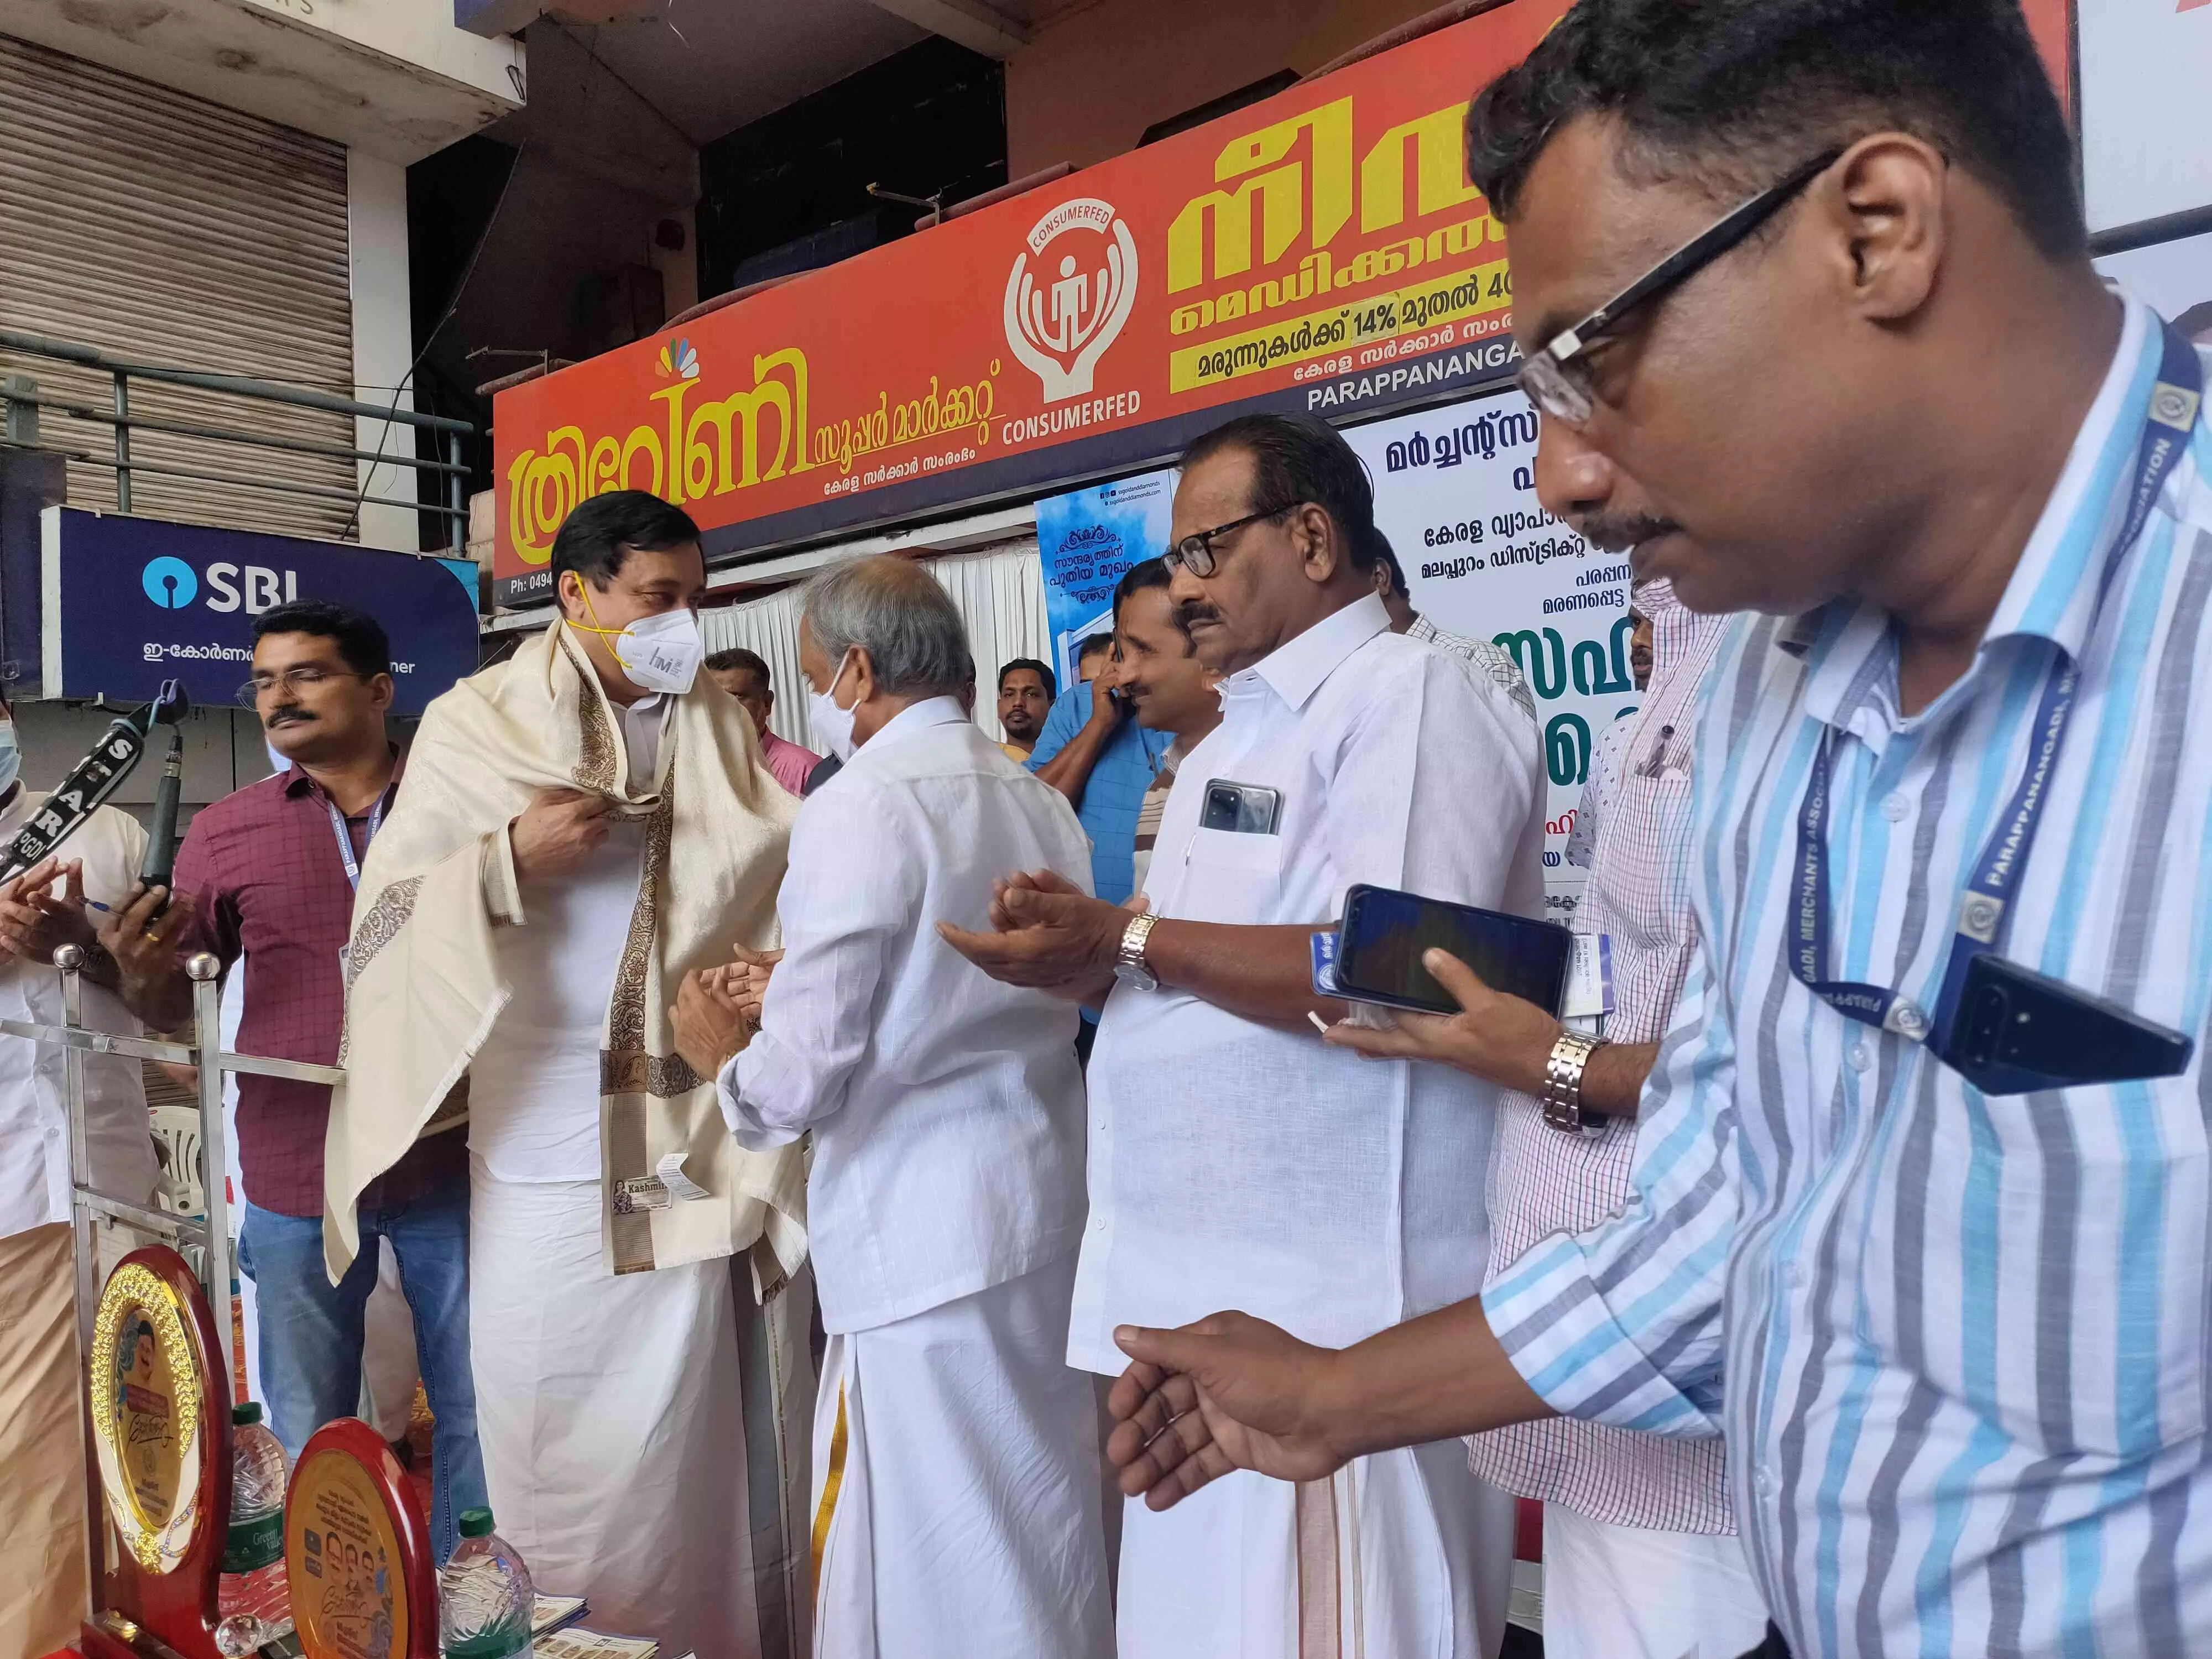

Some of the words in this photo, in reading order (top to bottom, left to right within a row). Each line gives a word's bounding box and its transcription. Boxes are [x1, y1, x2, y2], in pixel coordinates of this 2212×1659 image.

[1032, 205, 1110, 248] CONSUMERFED
[1198, 309, 1350, 377] മരുന്നുകൾക്ക്
[1354, 302, 1397, 336] 14%
[1402, 274, 1479, 327] മുതൽ
[1293, 355, 1353, 380] കേരള
[1360, 325, 1455, 365] സർക്കാർ
[815, 391, 888, 474] സൂപ്പർ
[893, 358, 1000, 446] മാർക്കറ്റ്
[1002, 390, 1141, 445] CONSUMERFED
[824, 476, 859, 495] കേരള
[863, 456, 918, 486] സർക്കാർ
[923, 447, 976, 471] സംരംഭം
[1424, 520, 1483, 547] കേരള
[206, 562, 298, 615] SBI
[510, 578, 527, 594] Ph:
[529, 571, 552, 590] 0494
[1050, 566, 1093, 588] പുതിയ
[1099, 560, 1134, 579] മുഖം
[1421, 556, 1485, 579] മലപ്പുറം
[1543, 588, 1625, 614] മരണപ്പെട്ട
[1986, 698, 2072, 886] PARAPPANANGADI,
[1801, 843, 1818, 941] MERCHANTS
